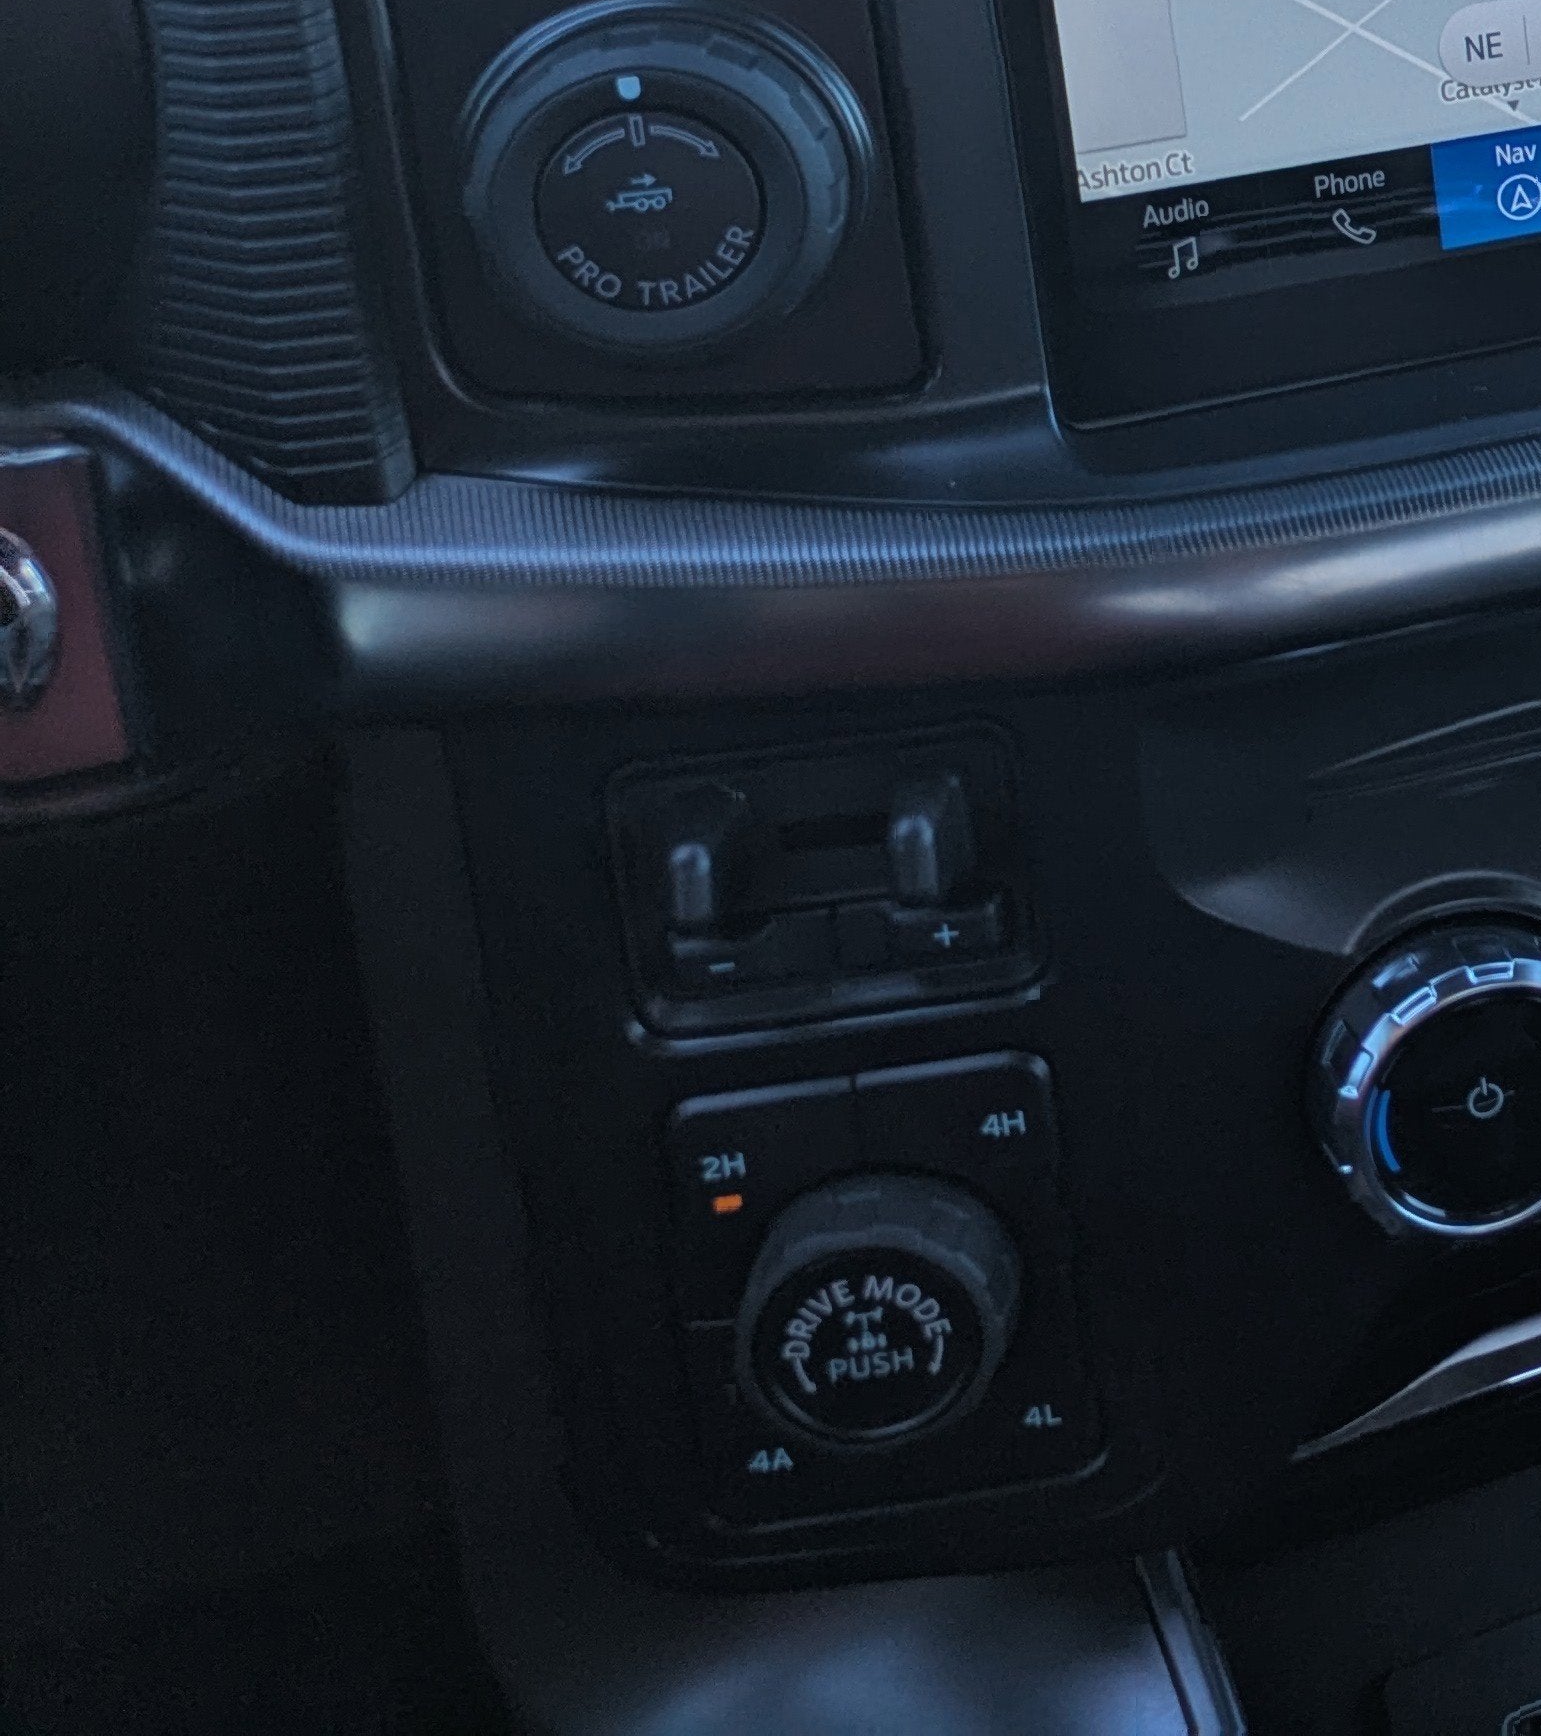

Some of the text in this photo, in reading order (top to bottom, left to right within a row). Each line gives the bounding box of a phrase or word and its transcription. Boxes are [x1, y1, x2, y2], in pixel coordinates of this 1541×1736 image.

[1464, 31, 1504, 63] NE
[1495, 142, 1537, 168] Nav
[1077, 152, 1194, 190] Ashton Ct
[1314, 169, 1386, 198] Phone
[1142, 198, 1209, 228] Audio
[557, 224, 755, 306] PRO TRAILER
[981, 1109, 1026, 1137] 4H
[701, 1151, 747, 1181] 2H
[782, 1274, 953, 1364] DRIVE MODE
[828, 1346, 915, 1384] PUSH
[1024, 1406, 1062, 1429] 4L
[747, 1448, 793, 1474] 4A
